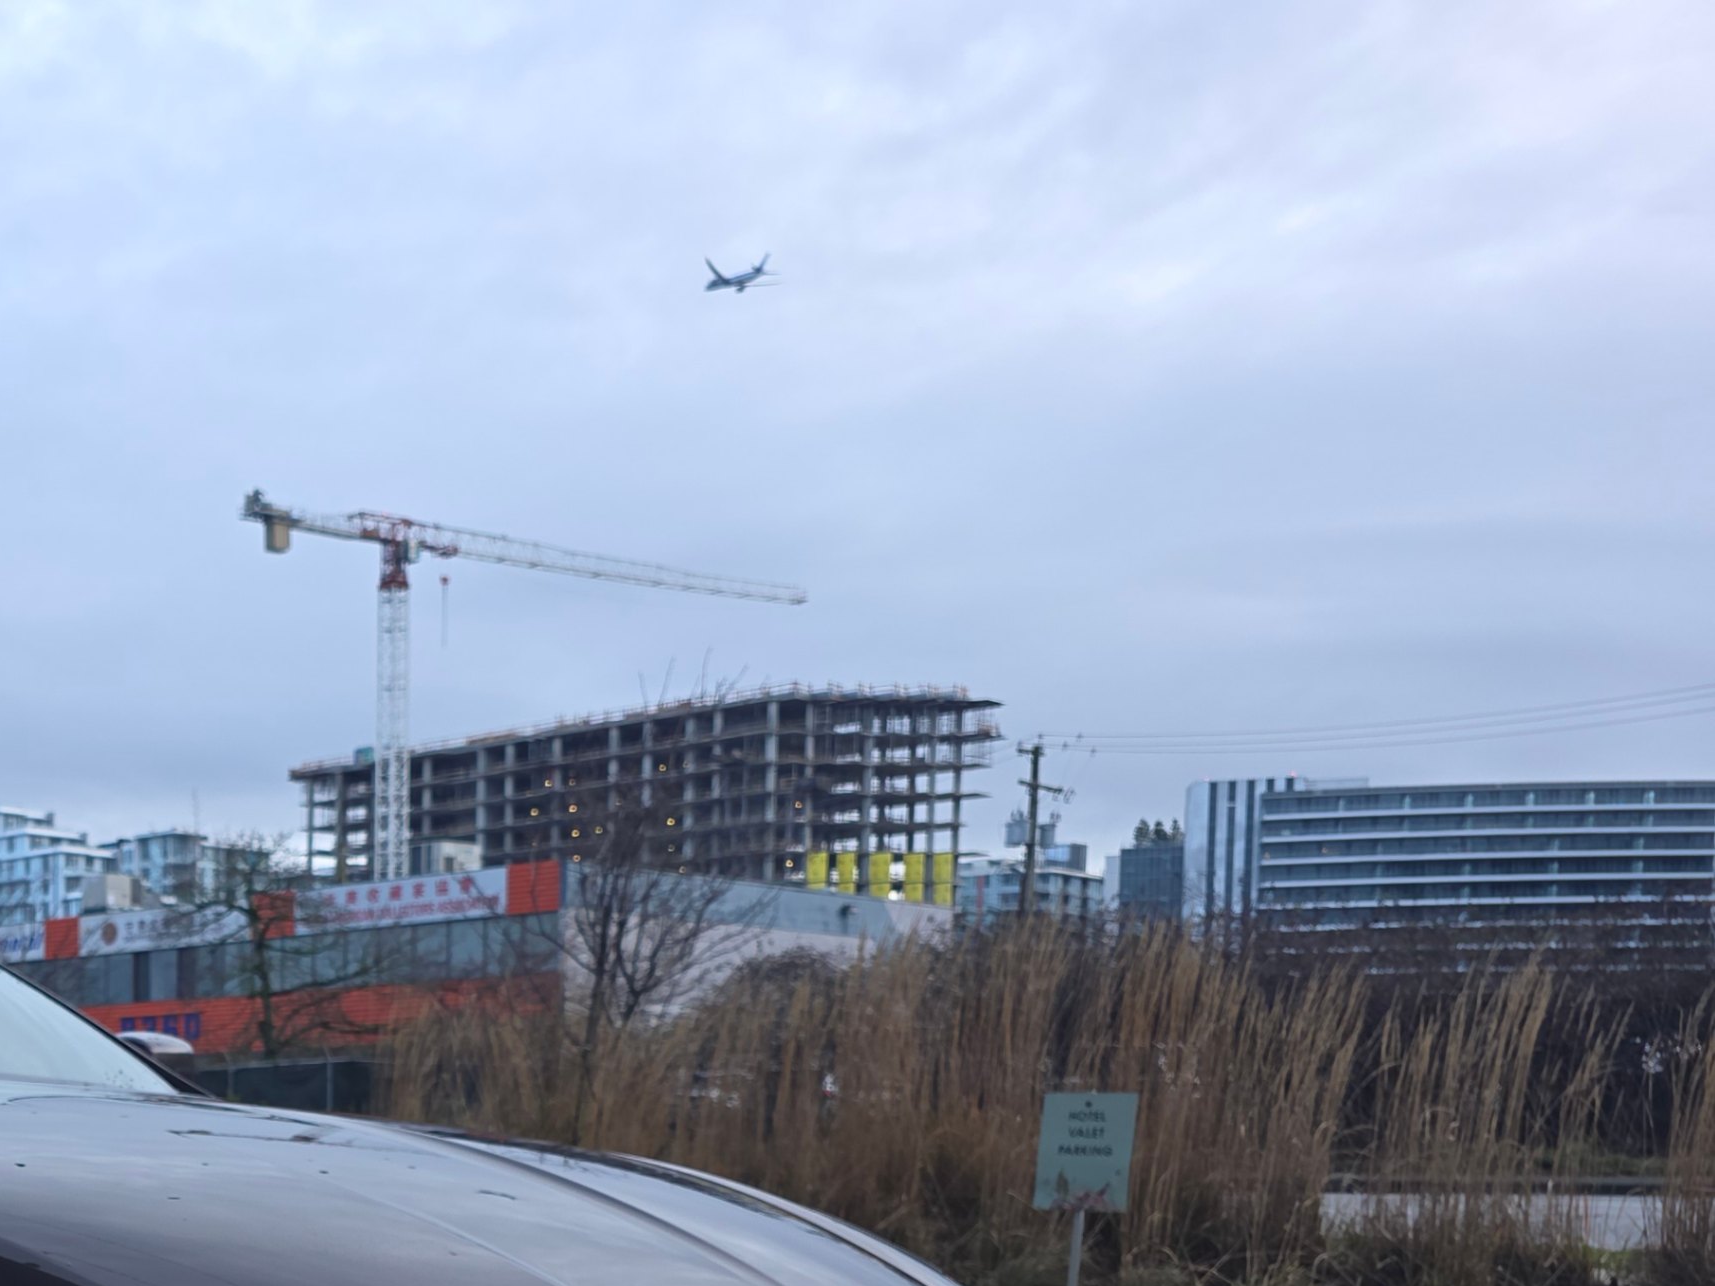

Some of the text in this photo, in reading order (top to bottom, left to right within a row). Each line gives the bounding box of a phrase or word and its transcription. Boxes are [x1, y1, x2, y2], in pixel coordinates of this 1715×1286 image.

[1068, 1111, 1106, 1123] HOTEL
[1068, 1127, 1105, 1139] VALET
[1057, 1145, 1113, 1157] PARKING
